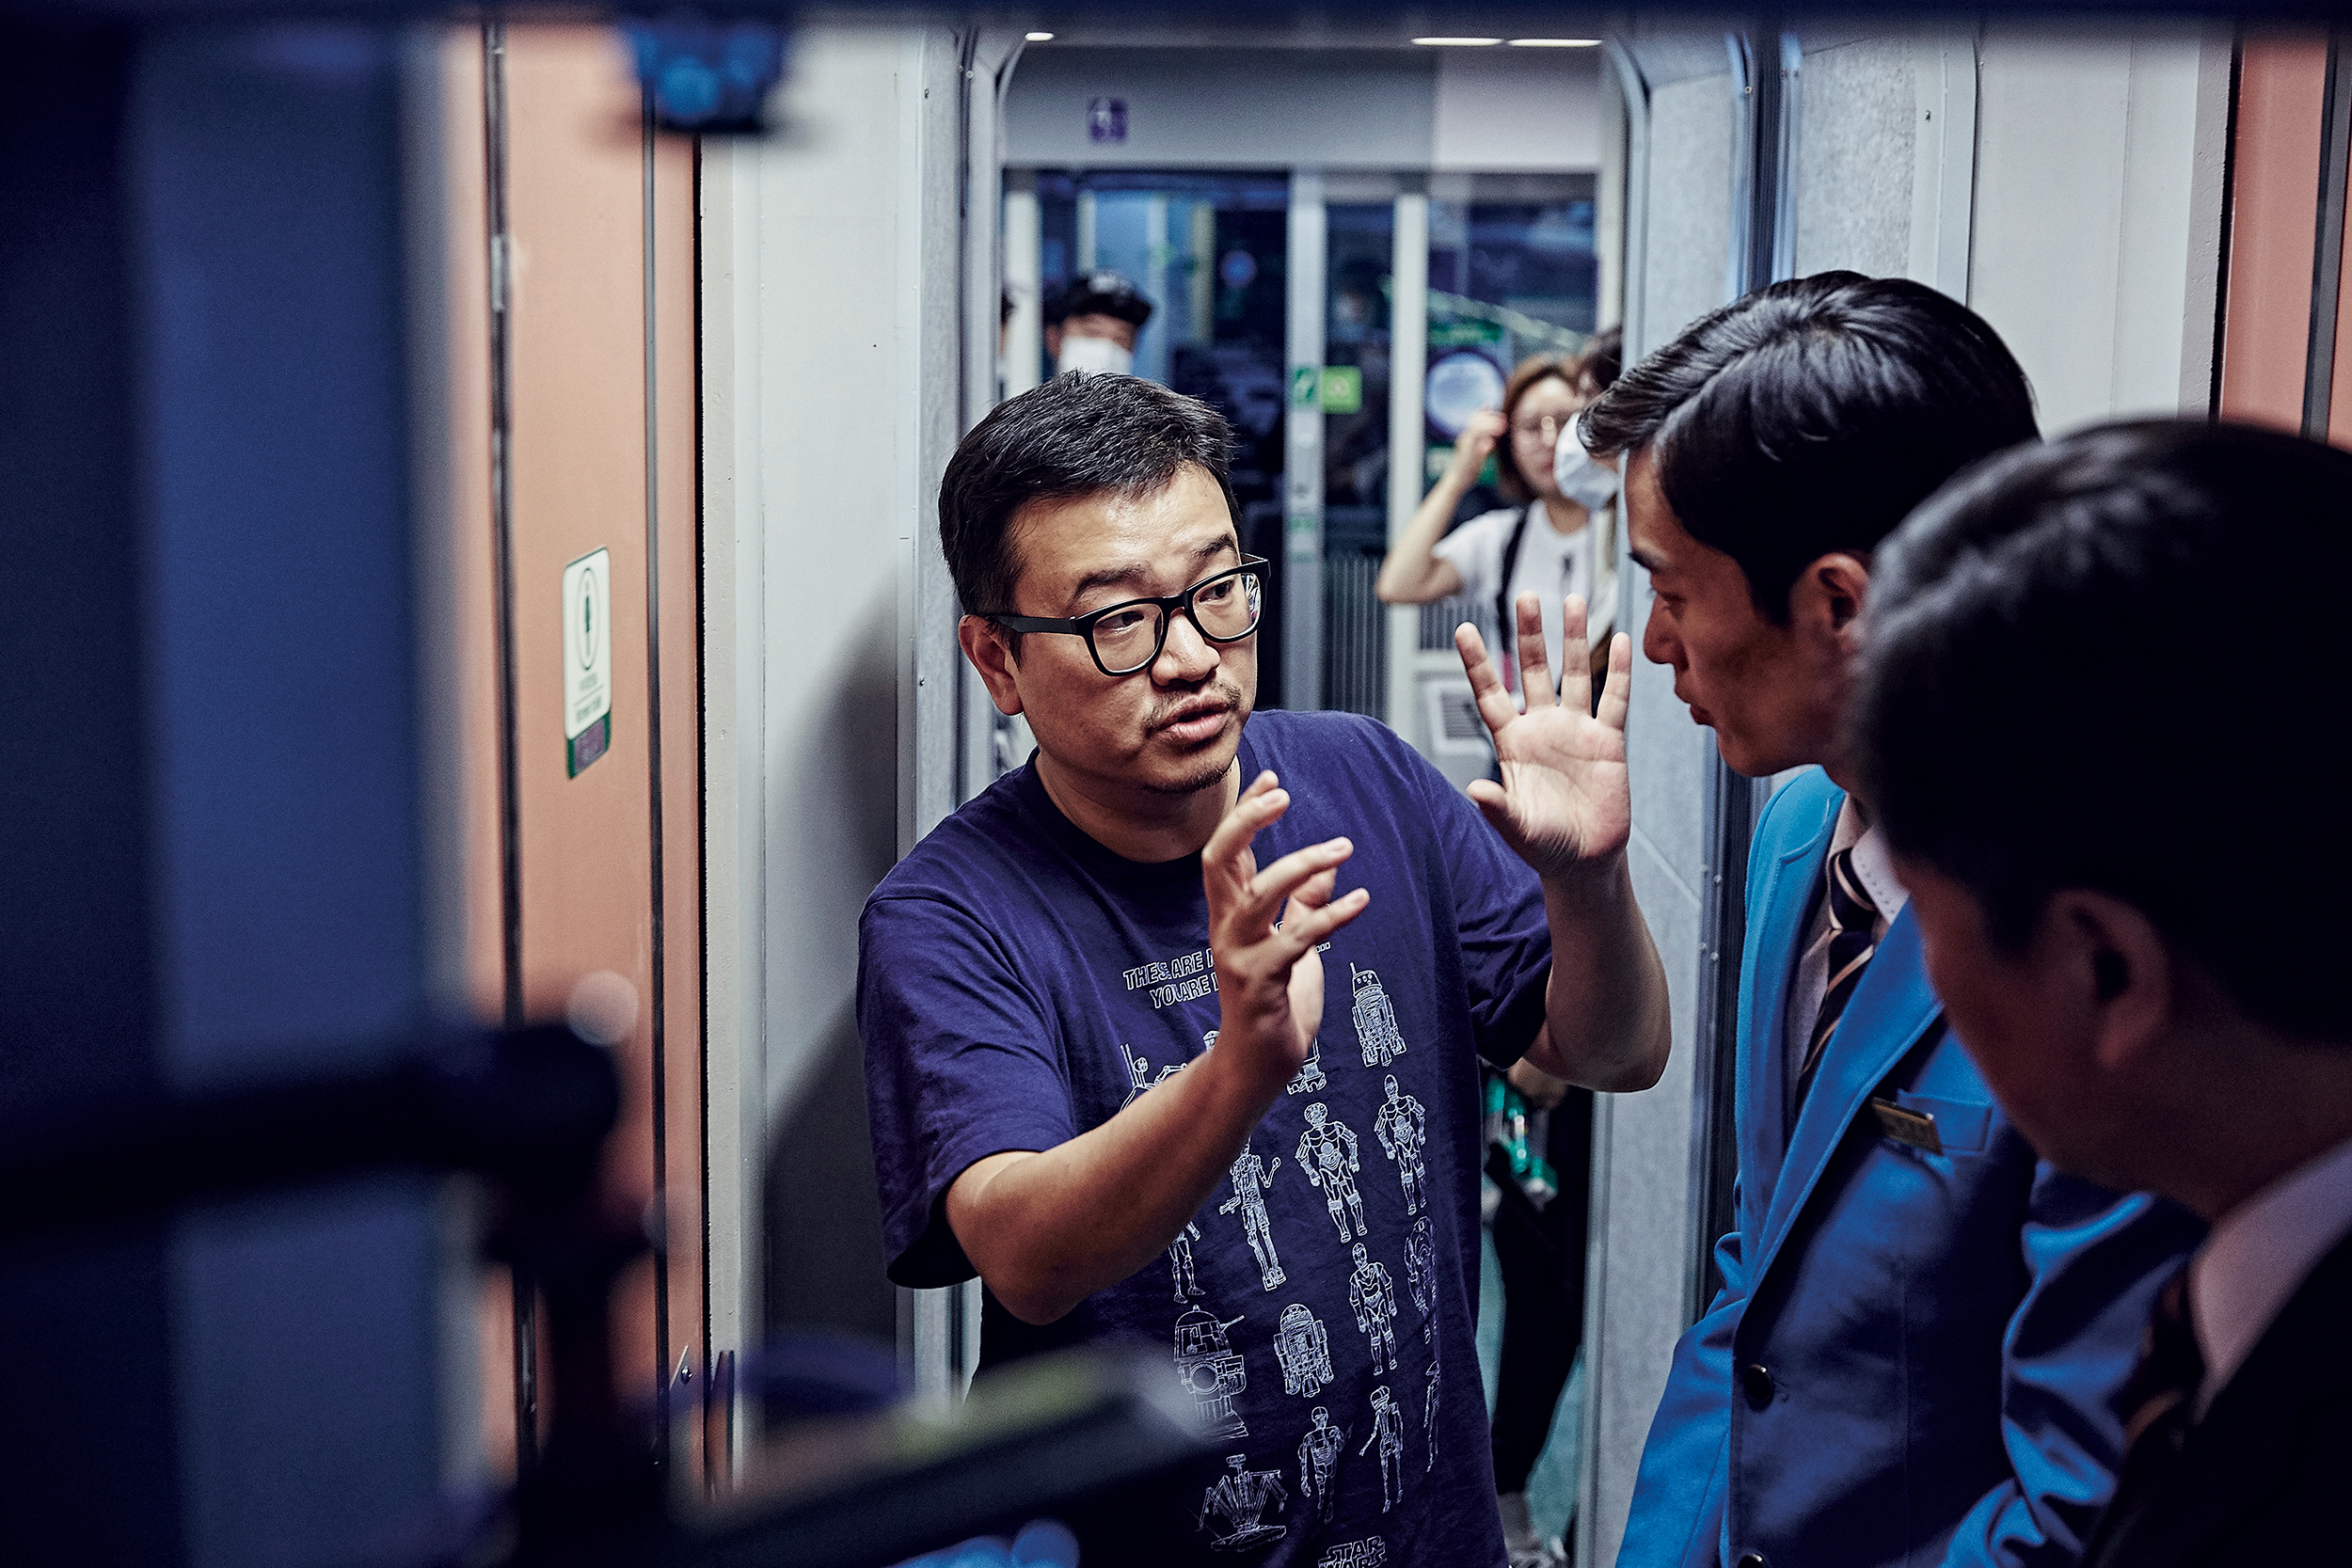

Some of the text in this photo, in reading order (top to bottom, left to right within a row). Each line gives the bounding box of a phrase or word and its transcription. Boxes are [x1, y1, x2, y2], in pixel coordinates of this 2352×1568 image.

[1122, 961, 1172, 990] THES
[1170, 951, 1204, 979] ARE
[1318, 1535, 1386, 1563] STAR
